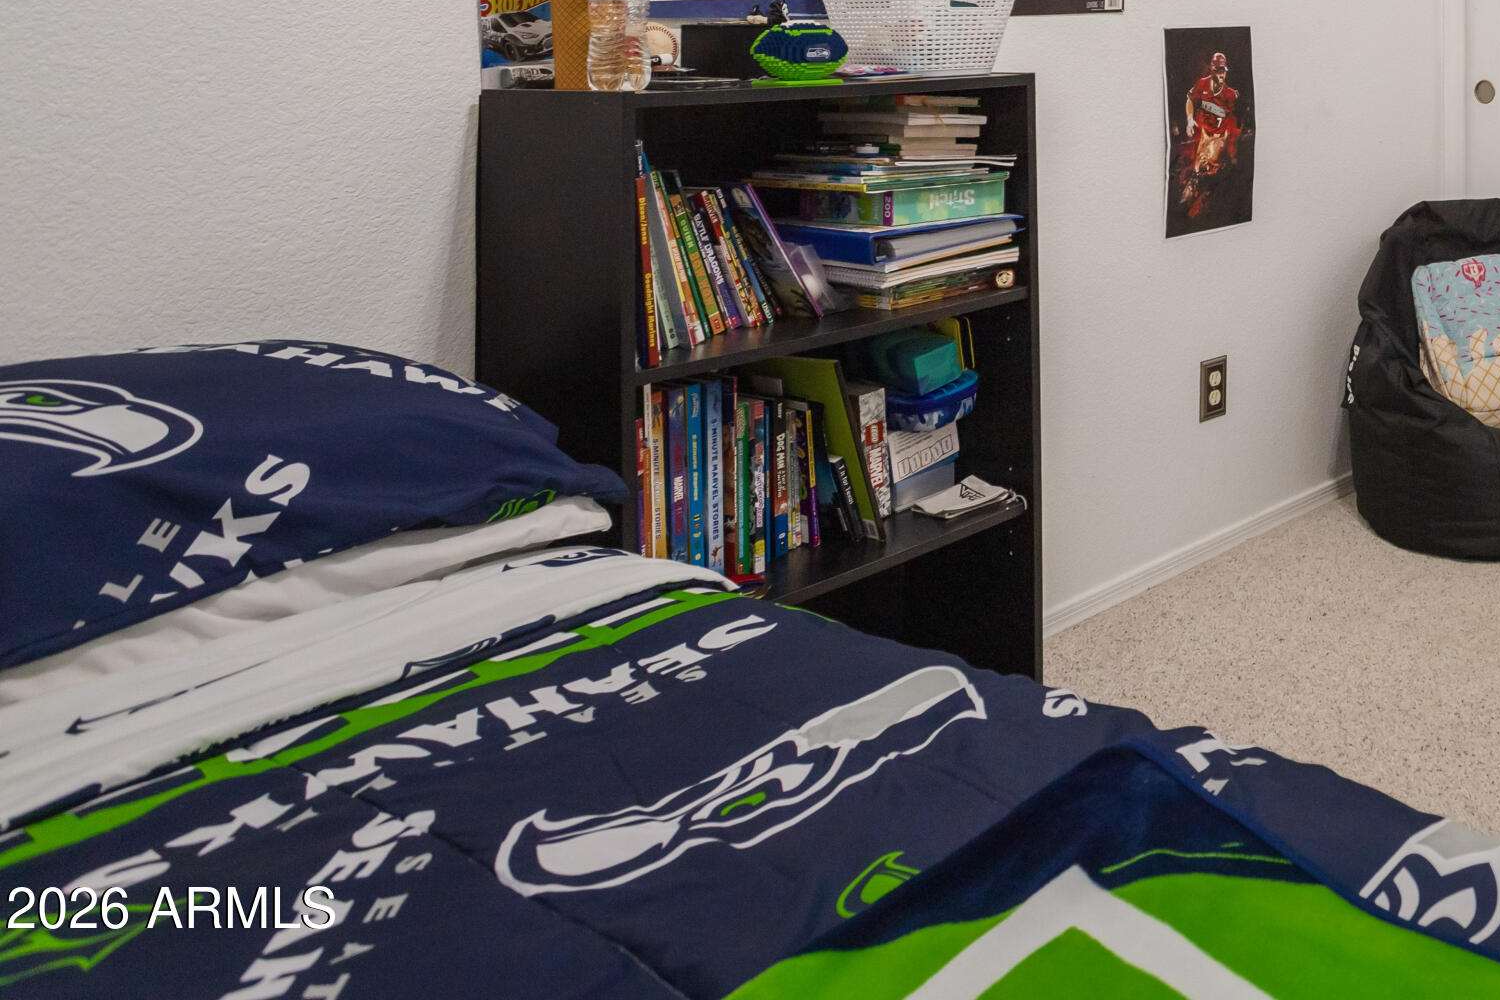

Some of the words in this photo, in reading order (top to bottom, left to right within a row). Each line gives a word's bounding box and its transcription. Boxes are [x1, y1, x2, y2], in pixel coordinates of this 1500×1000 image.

[1216, 117, 1223, 128] 7
[776, 432, 785, 452] DOG
[776, 452, 786, 470] MAN
[868, 446, 883, 489] MARVEL
[673, 475, 684, 503] MARVEL
[711, 463, 719, 500] MARVEL
